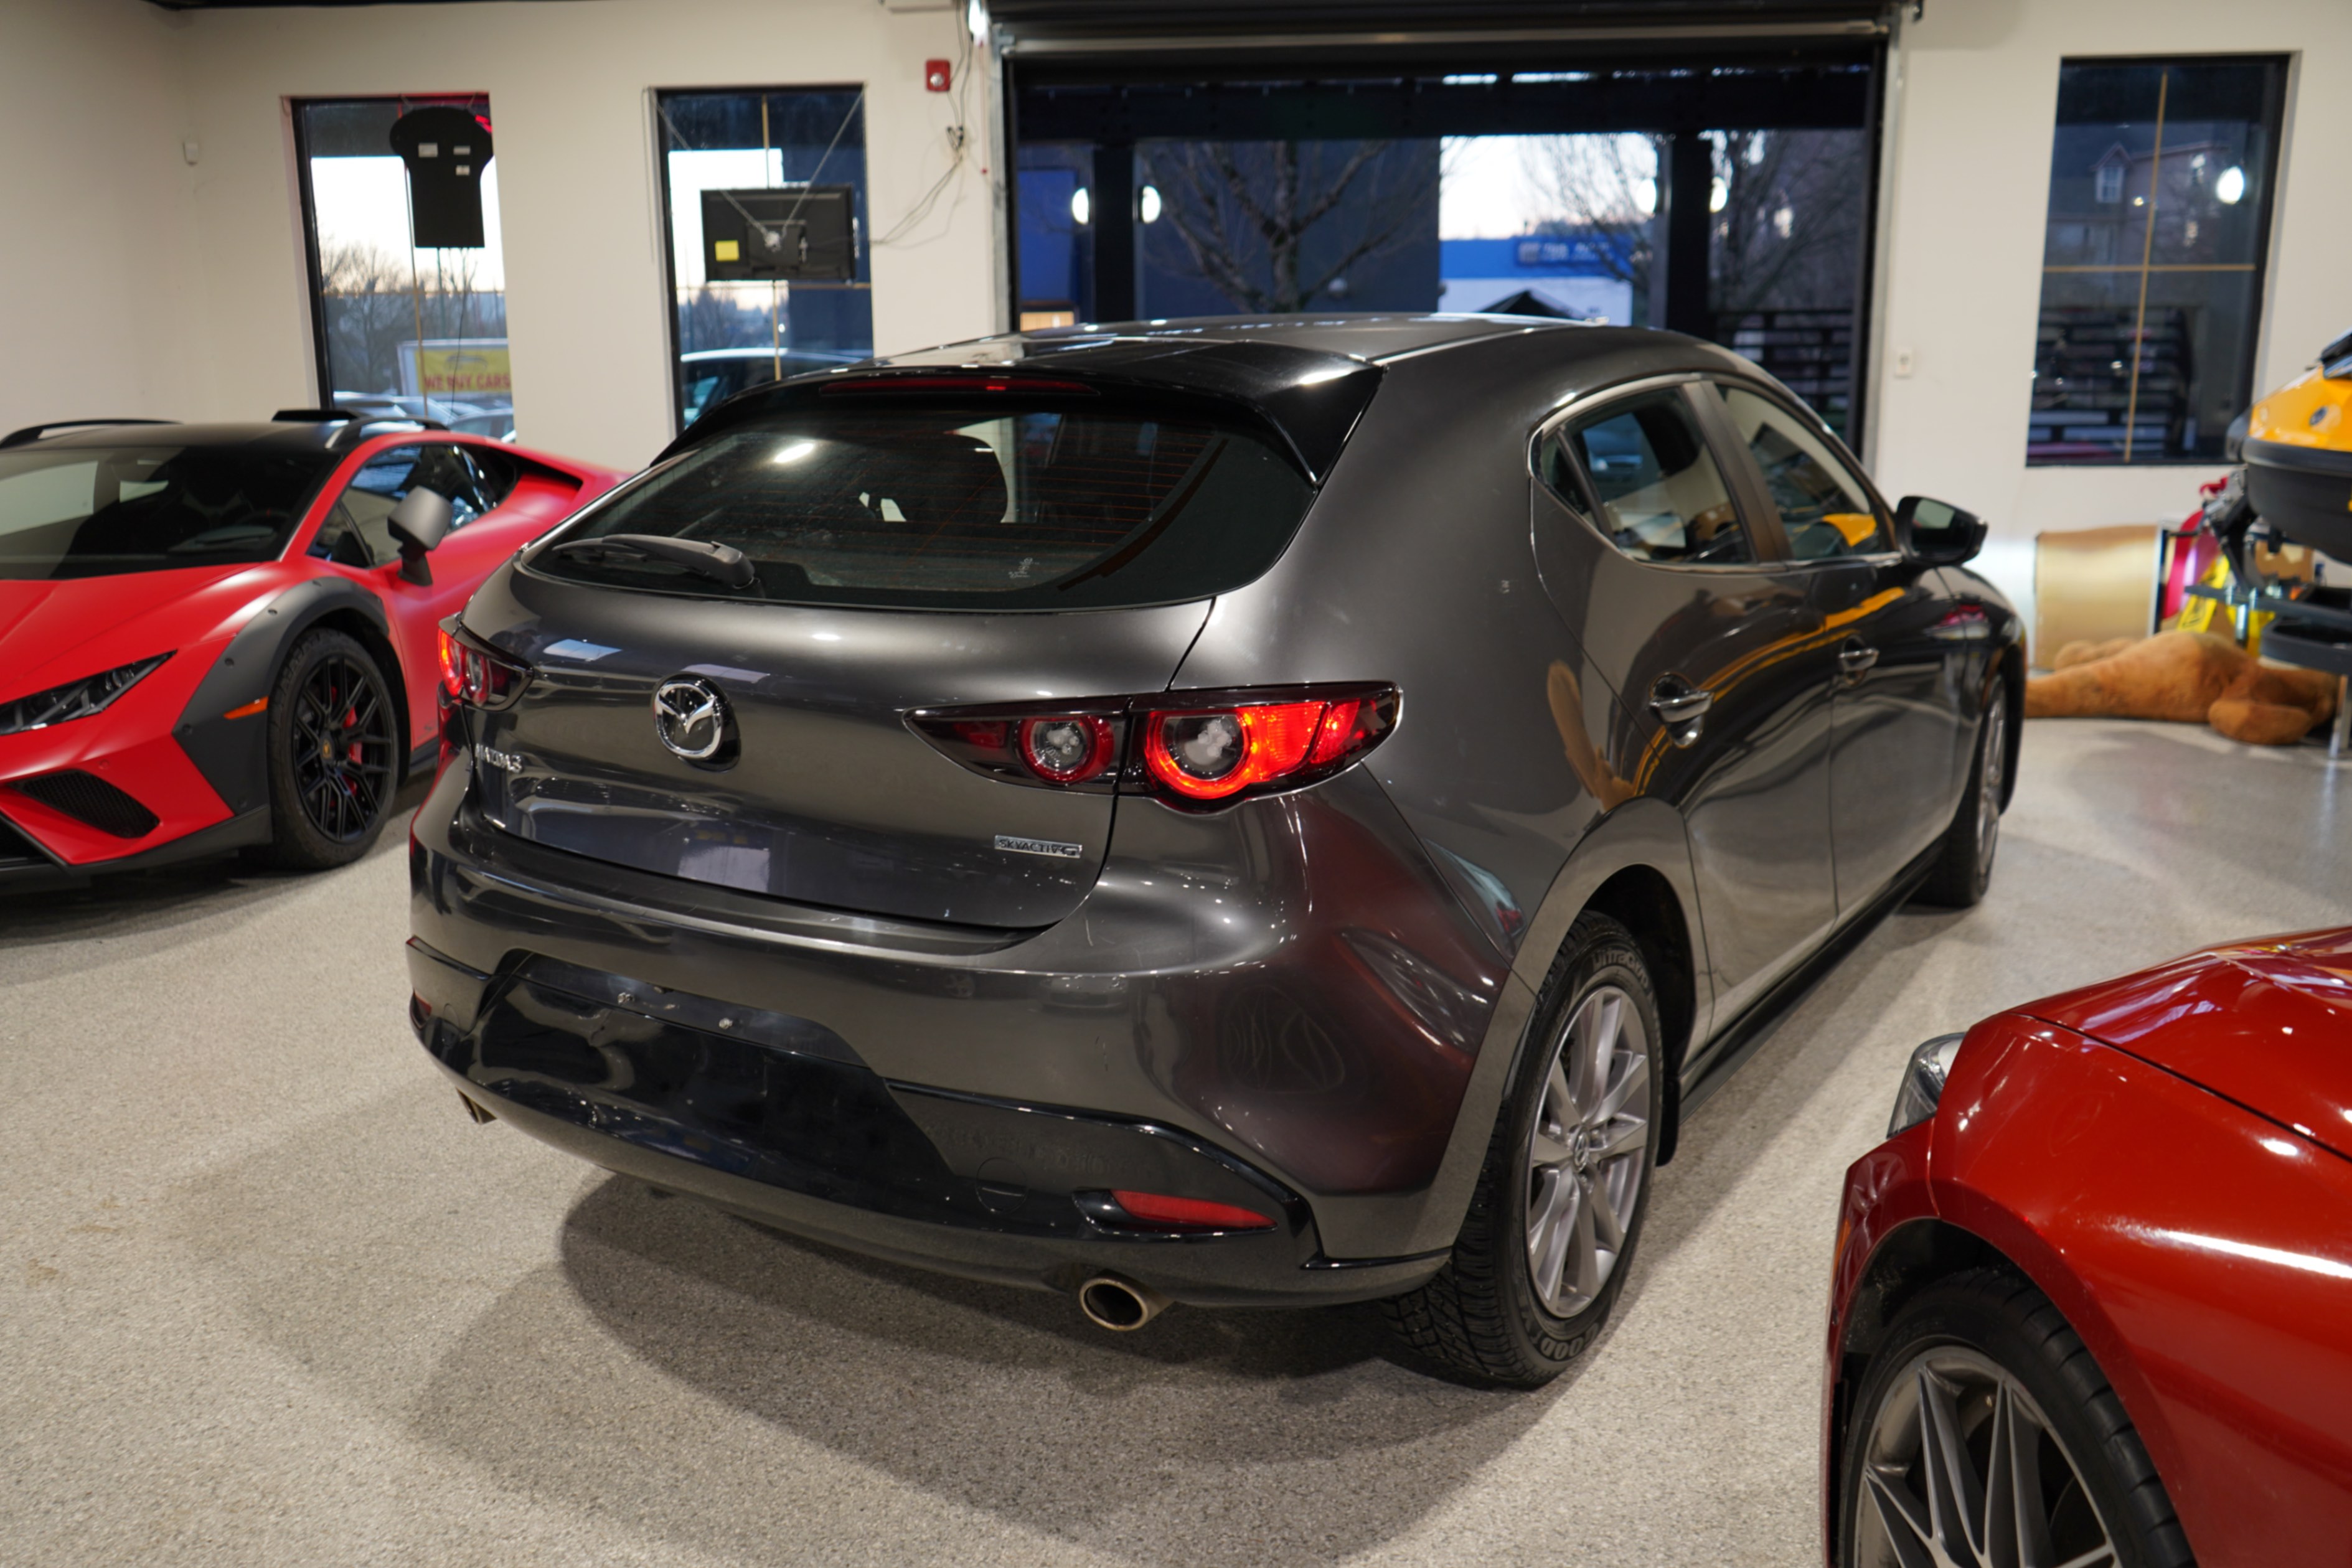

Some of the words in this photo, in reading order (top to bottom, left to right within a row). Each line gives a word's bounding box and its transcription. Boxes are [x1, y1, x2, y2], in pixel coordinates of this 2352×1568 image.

[425, 375, 444, 390] WE
[447, 375, 471, 390] BUY
[477, 373, 511, 390] CARS
